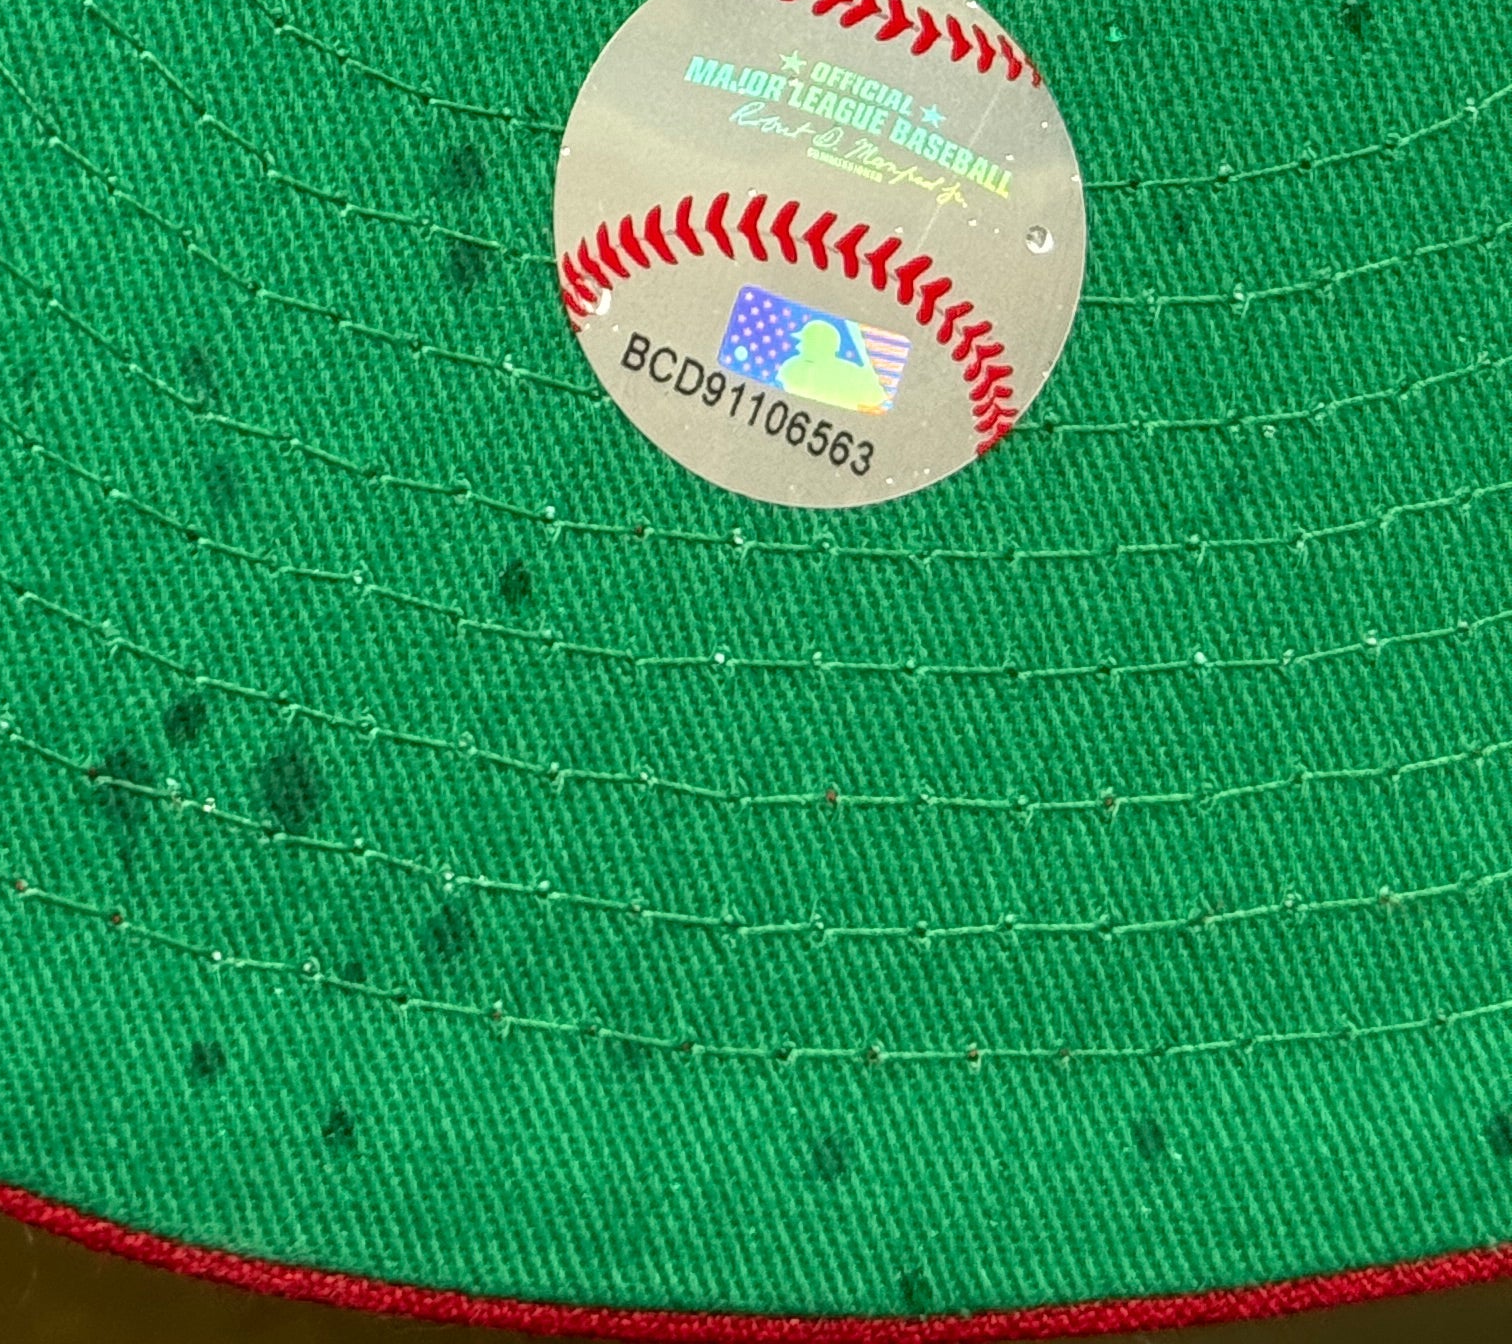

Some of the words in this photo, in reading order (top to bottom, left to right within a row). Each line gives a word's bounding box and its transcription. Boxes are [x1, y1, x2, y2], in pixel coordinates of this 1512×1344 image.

[684, 55, 788, 102] MAJOR
[788, 80, 889, 136] LEAGUE
[889, 115, 1013, 199] BASEBALL
[810, 61, 914, 116] OFFICIAL
[620, 332, 875, 477] BCD91106563
